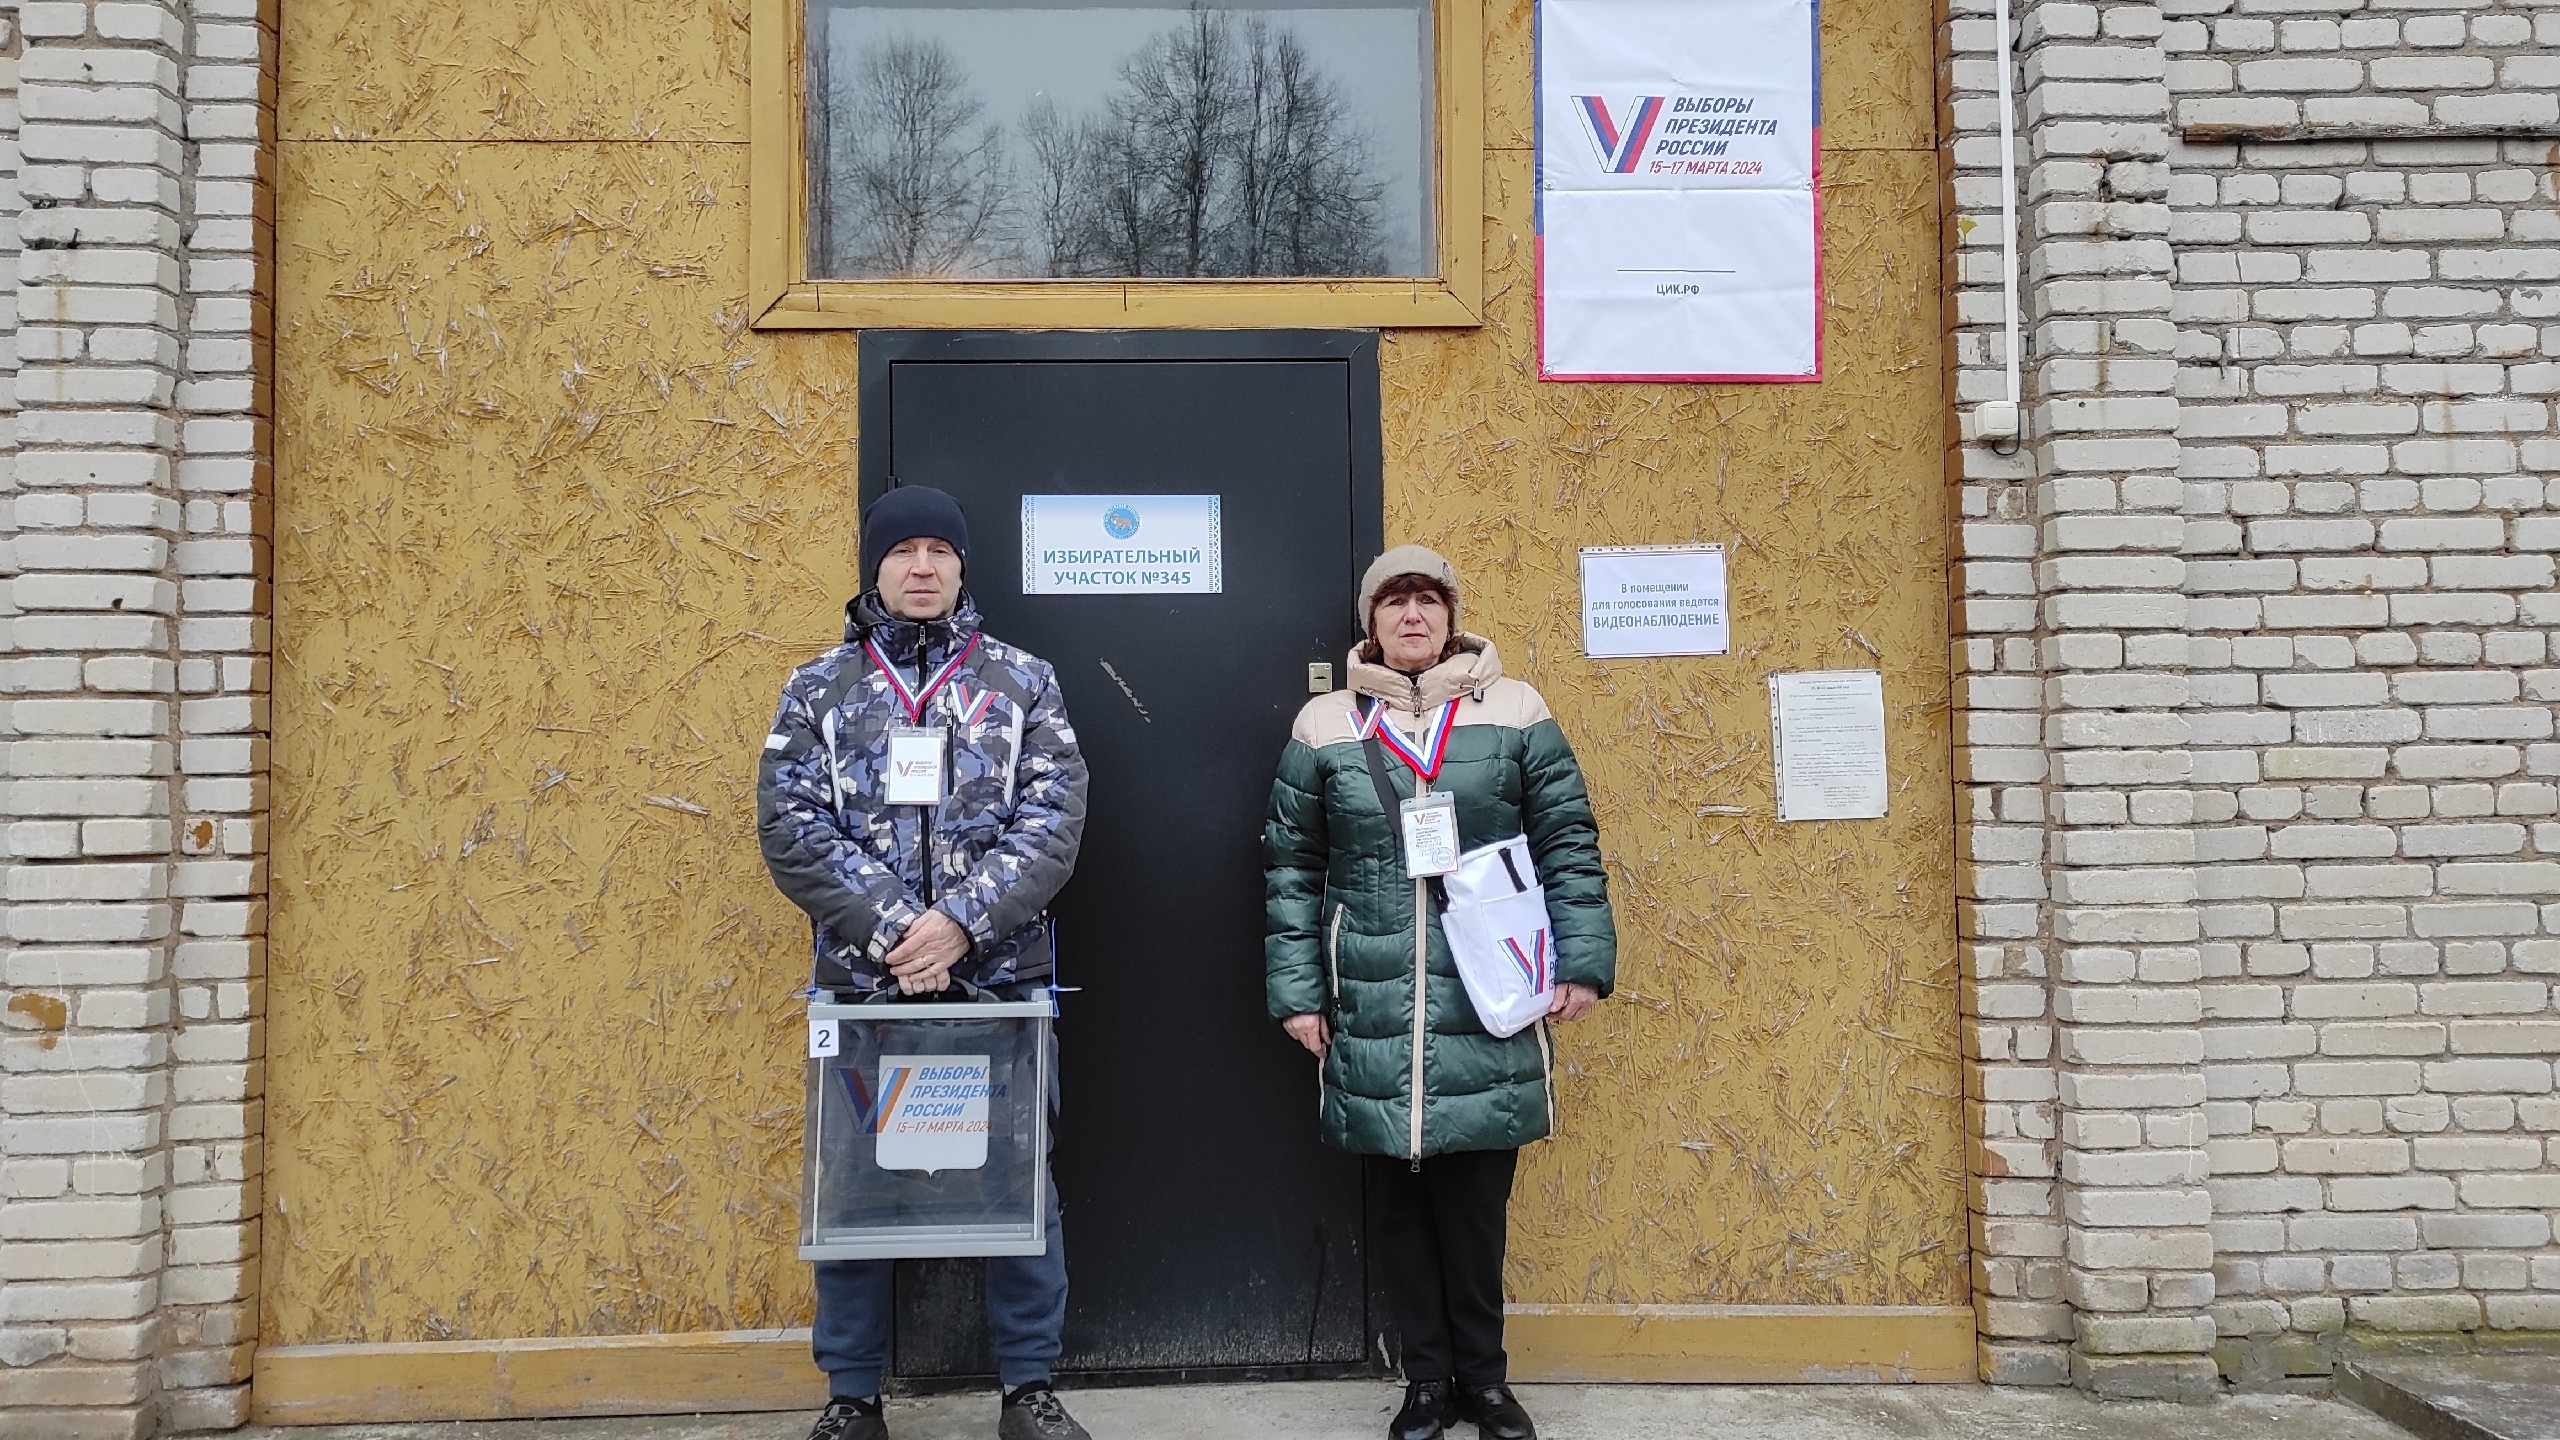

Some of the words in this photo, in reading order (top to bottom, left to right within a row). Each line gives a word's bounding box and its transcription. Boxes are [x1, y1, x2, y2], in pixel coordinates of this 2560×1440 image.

[1672, 96, 1755, 114] ВЫБОРЫ
[1664, 118, 1778, 137] ПРЕЗИДЕНТА
[1655, 139, 1729, 156] РОССИИ
[1684, 160, 1729, 175] МАРТА
[1731, 160, 1763, 175] 2024
[1656, 284, 1700, 296] ЦИК.РФ
[1043, 546, 1201, 564] ИЗБИРАТЕЛЬНЫЙ
[1053, 570, 1137, 585] УЧАСТОК
[1141, 570, 1191, 585] №345
[1621, 583, 1628, 594] В
[1630, 583, 1690, 594] помещении
[1592, 601, 1611, 612] для
[1613, 599, 1677, 610] голосования
[1679, 598, 1719, 608] ведется
[1593, 613, 1720, 630] ВИДЕОНАБЛЮДЕНИЕ
[817, 1029, 831, 1049] 2
[918, 1066, 988, 1081] ВЫБОРЫ
[909, 1084, 1007, 1100] ПРЕЗИДЕНТА
[901, 1103, 966, 1117] РОССИИ
[926, 1120, 964, 1133] МАРТА
